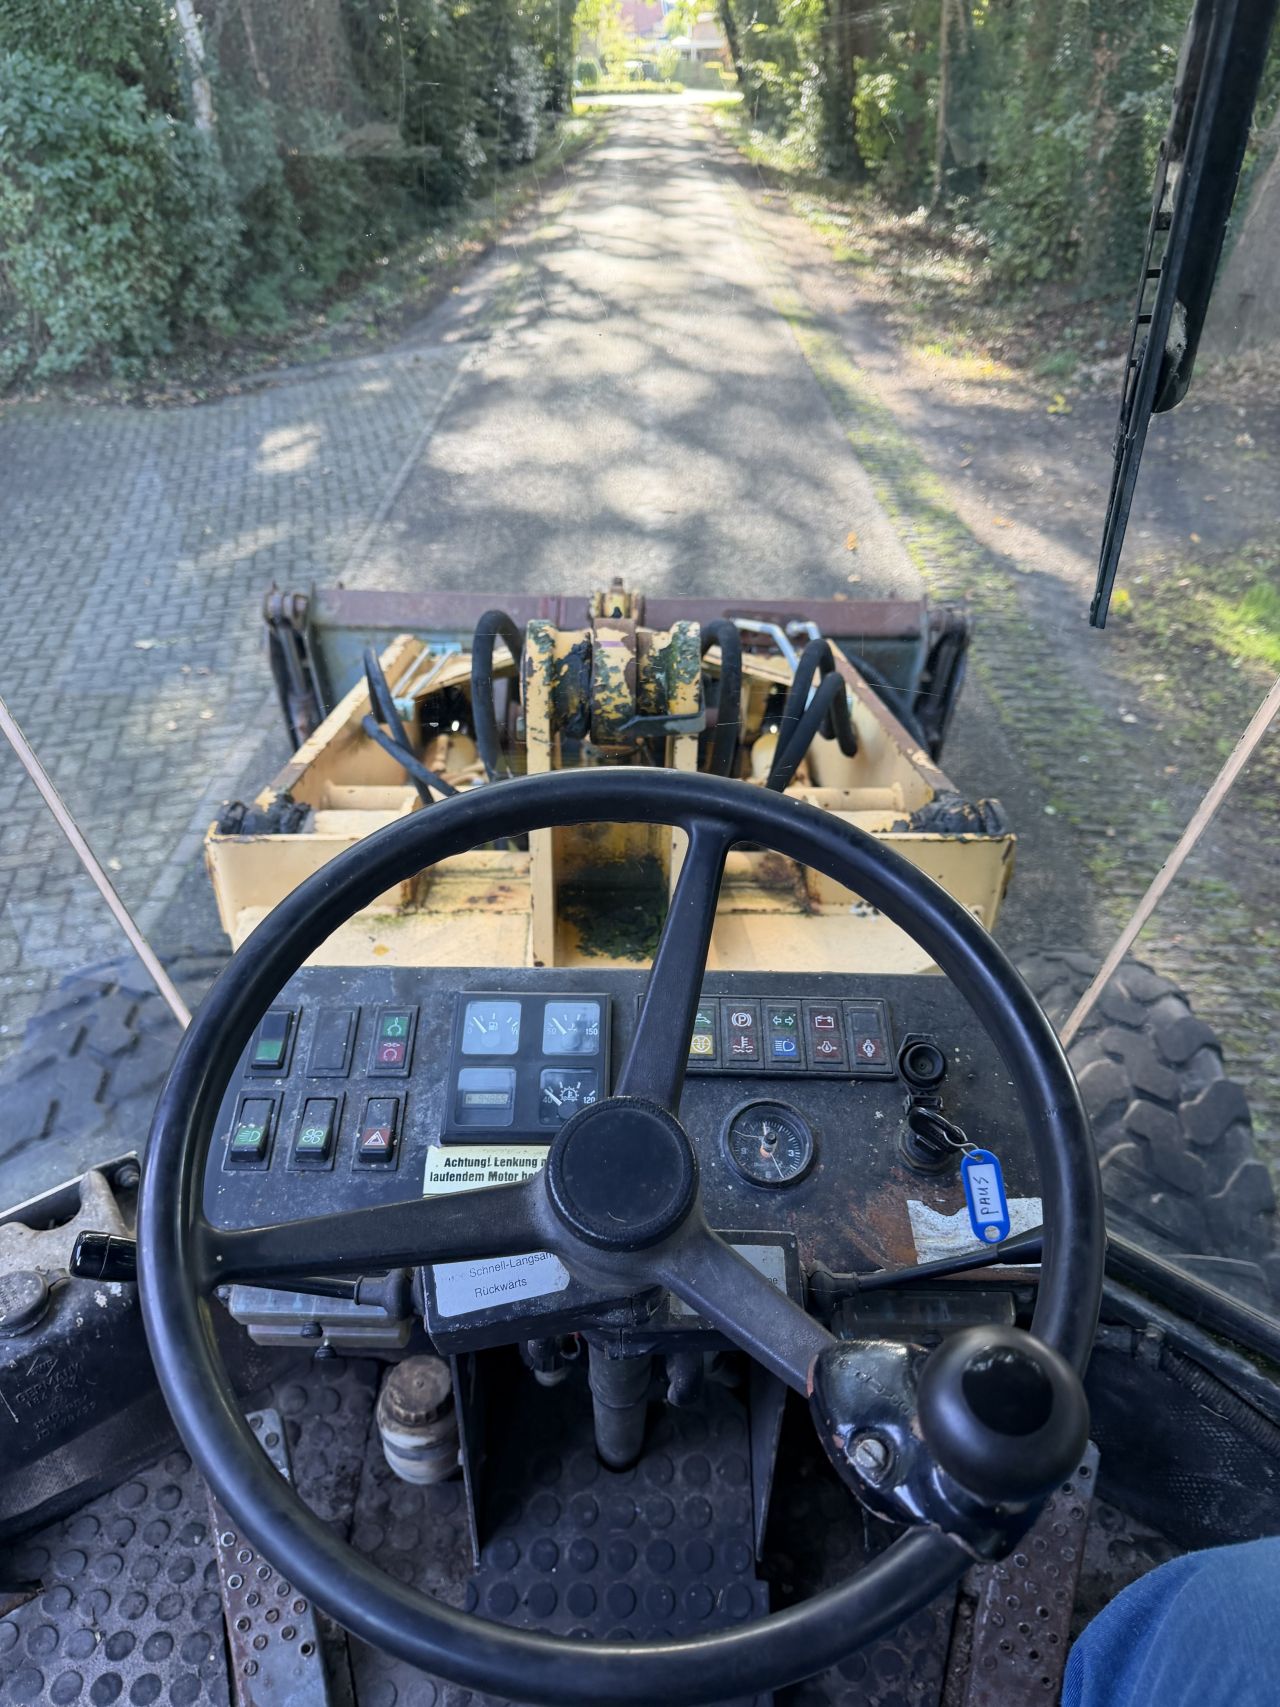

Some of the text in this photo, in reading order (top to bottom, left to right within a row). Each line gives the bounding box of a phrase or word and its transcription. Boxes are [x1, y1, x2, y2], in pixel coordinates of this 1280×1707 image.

[585, 1027, 598, 1036] 150
[583, 1096, 596, 1104] 120
[787, 1149, 795, 1157] 3
[444, 1157, 491, 1168] Achtung!
[494, 1157, 538, 1168] Lenkung
[430, 1171, 484, 1182] laufendem
[488, 1171, 519, 1182] Motor
[475, 1278, 528, 1298] Rückwärts
